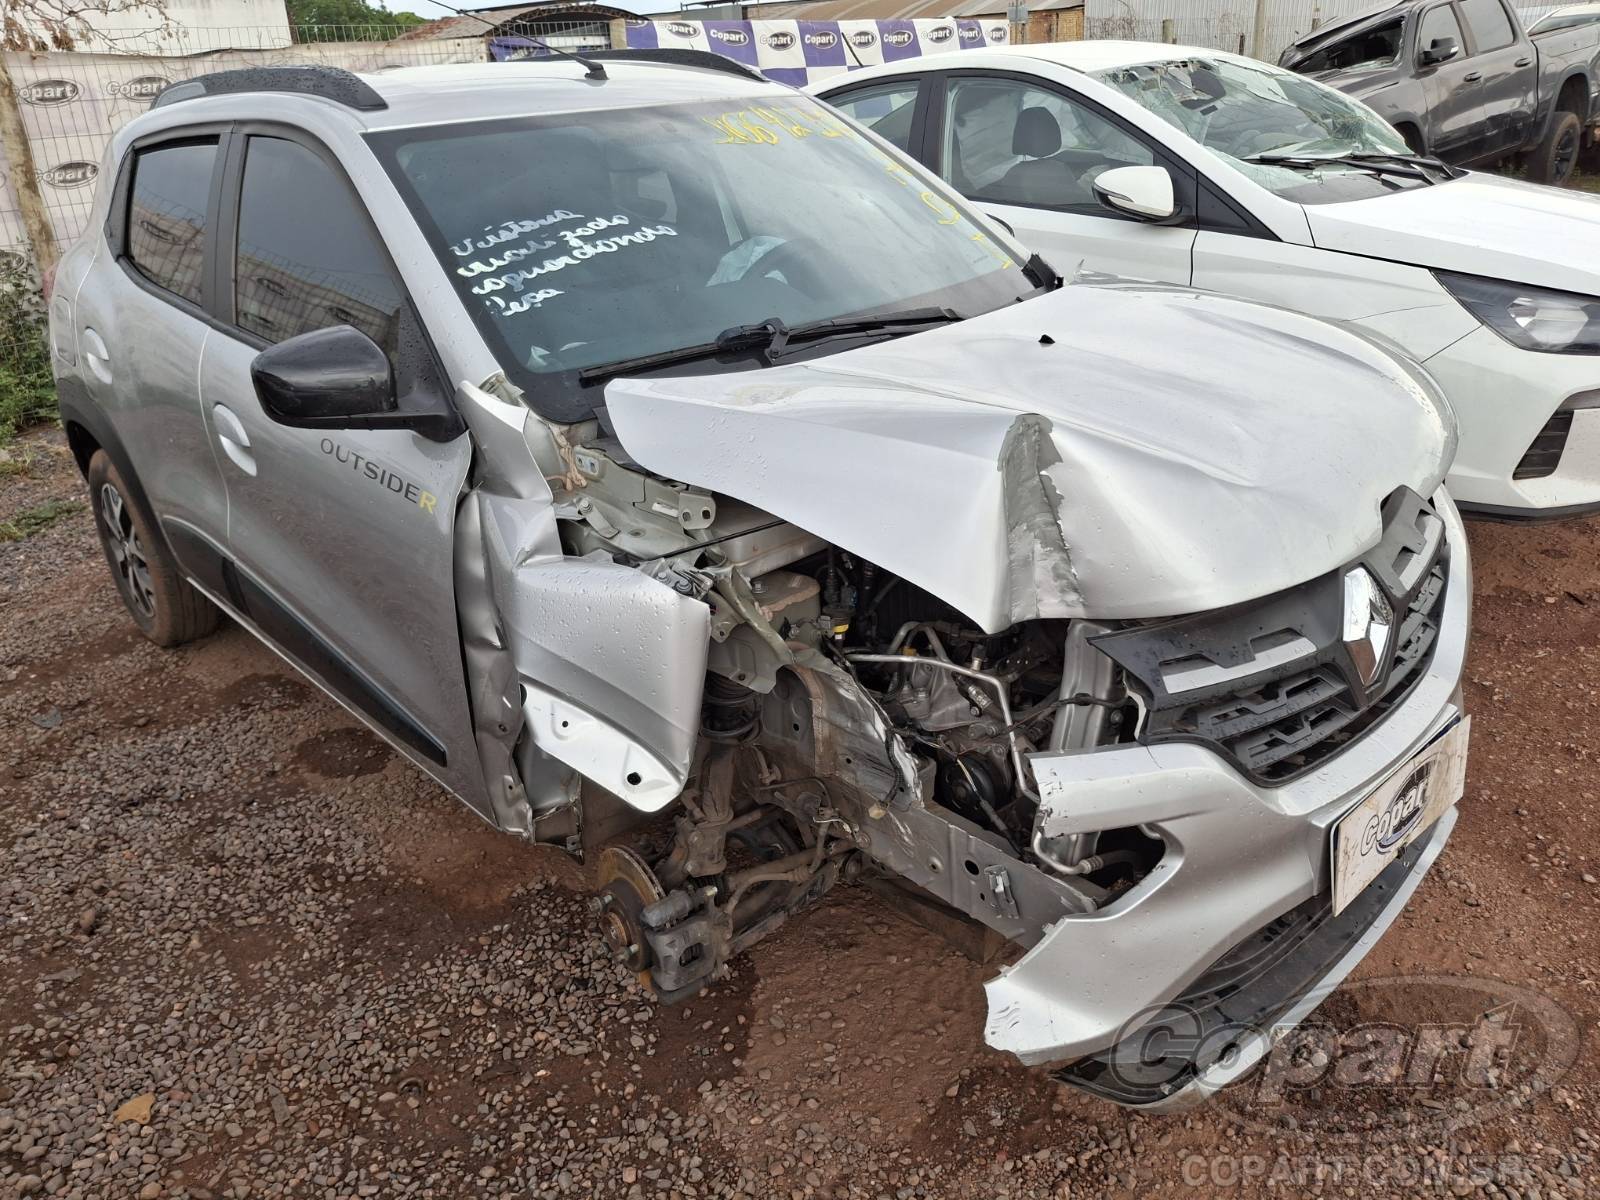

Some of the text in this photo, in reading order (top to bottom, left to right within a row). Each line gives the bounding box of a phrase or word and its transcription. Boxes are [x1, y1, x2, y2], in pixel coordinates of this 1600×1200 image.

[710, 28, 745, 43] Copart
[804, 33, 834, 46] Copart
[883, 33, 909, 44] Copart
[959, 27, 979, 39] Copart
[18, 84, 75, 102] opart
[320, 438, 437, 514] OUTSIDER
